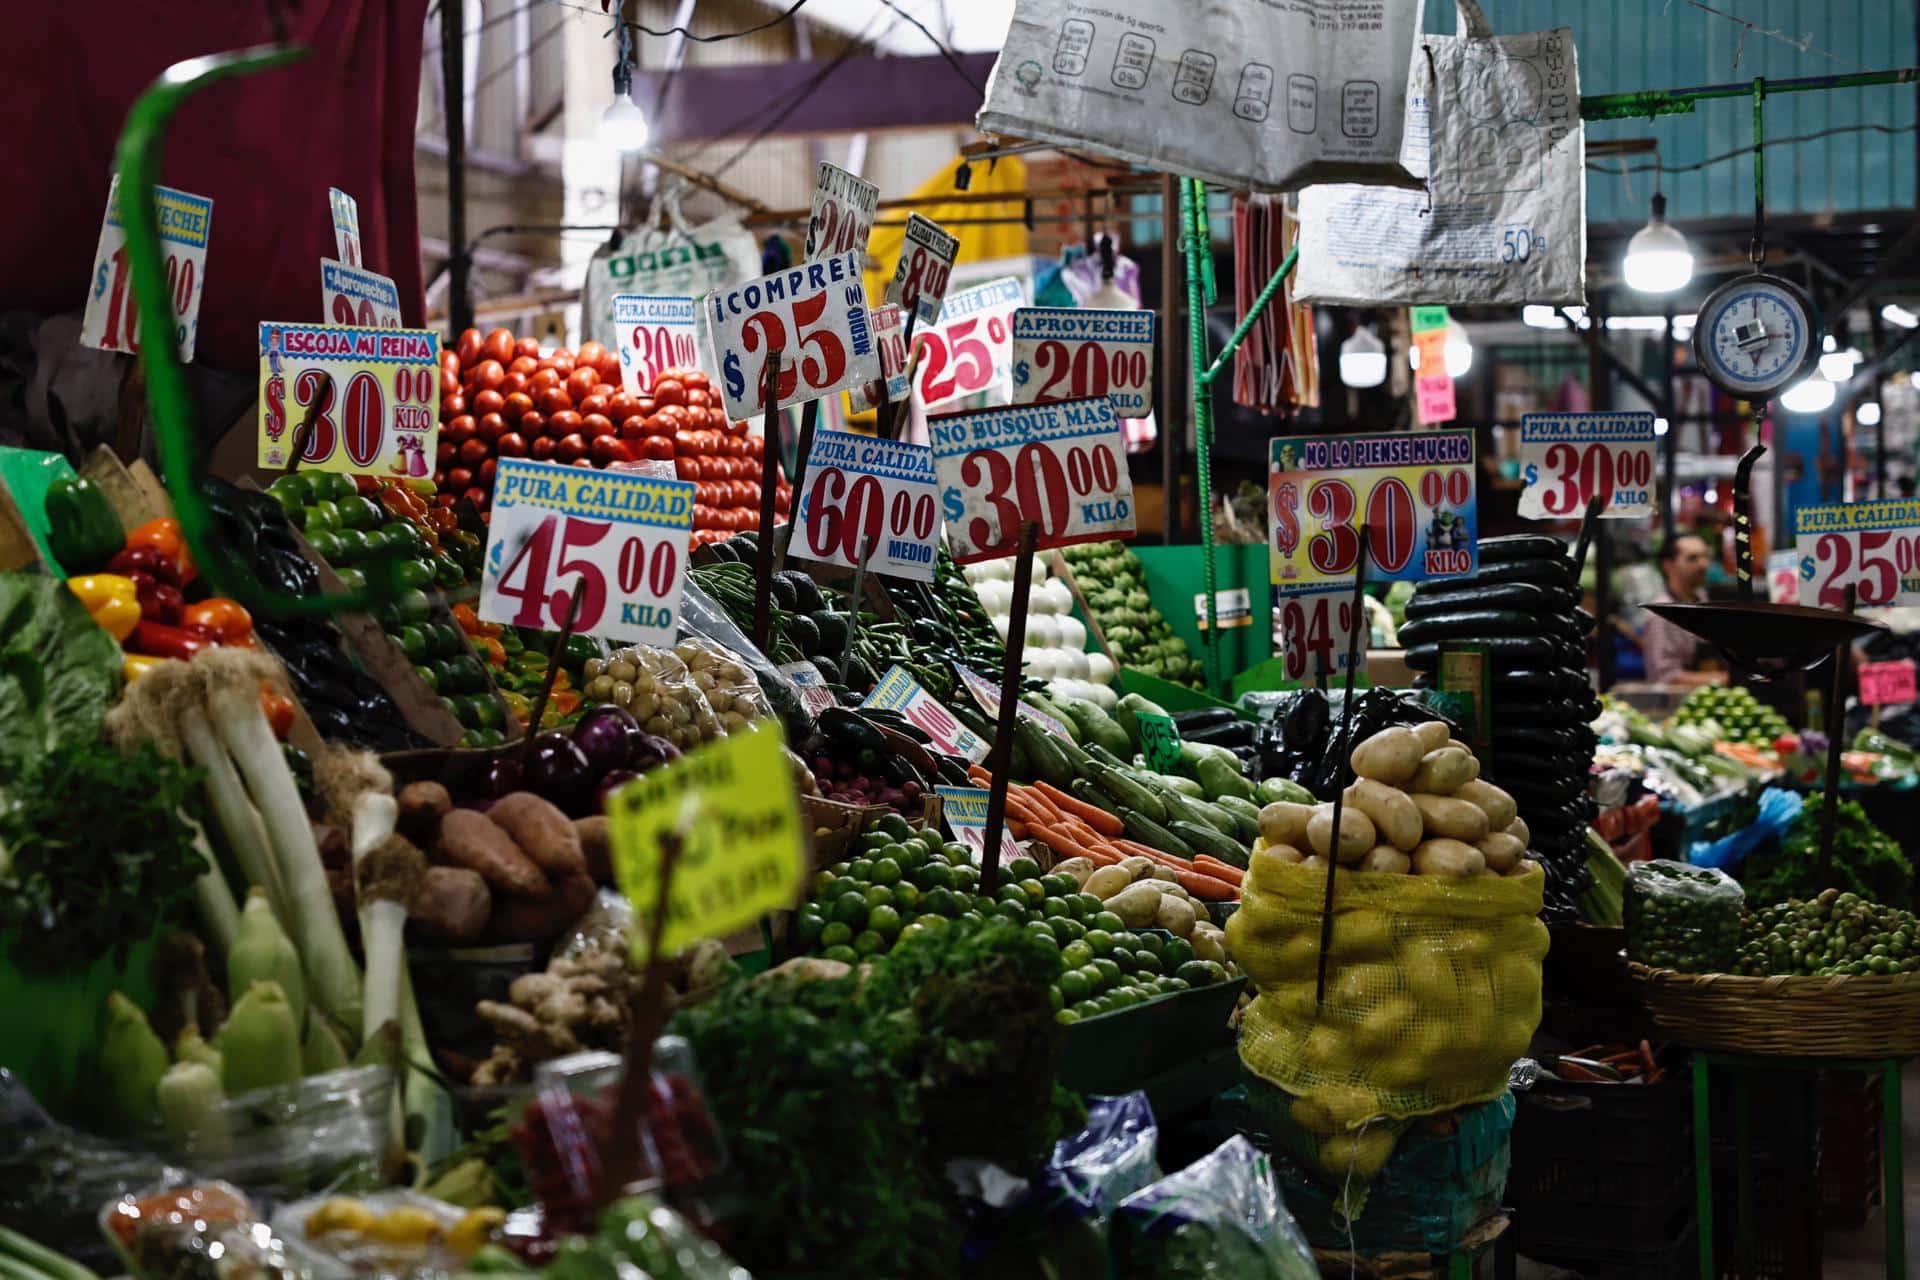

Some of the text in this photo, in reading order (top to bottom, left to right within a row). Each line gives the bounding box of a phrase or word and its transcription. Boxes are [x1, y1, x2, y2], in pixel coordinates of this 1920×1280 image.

[1502, 228, 1547, 265] 50 kg
[1019, 317, 1147, 335] APROVECHE
[284, 332, 431, 359] ESCOJA MI REINA
[392, 405, 433, 432] KILO
[935, 424, 967, 446] NO
[973, 410, 1060, 440] BUSQUE
[1529, 420, 1649, 436] PURA CALIDAD
[814, 440, 936, 475] PURA CALIDA
[1305, 435, 1470, 468] NO LO PIENSE MUCHO
[503, 474, 689, 517] PURA CALIDAD
[1614, 490, 1649, 505] KILO
[1081, 499, 1129, 524] KILO
[1802, 504, 1920, 528] PURA CALIDA
[1424, 550, 1472, 575] KILO
[620, 601, 673, 630] KILO
